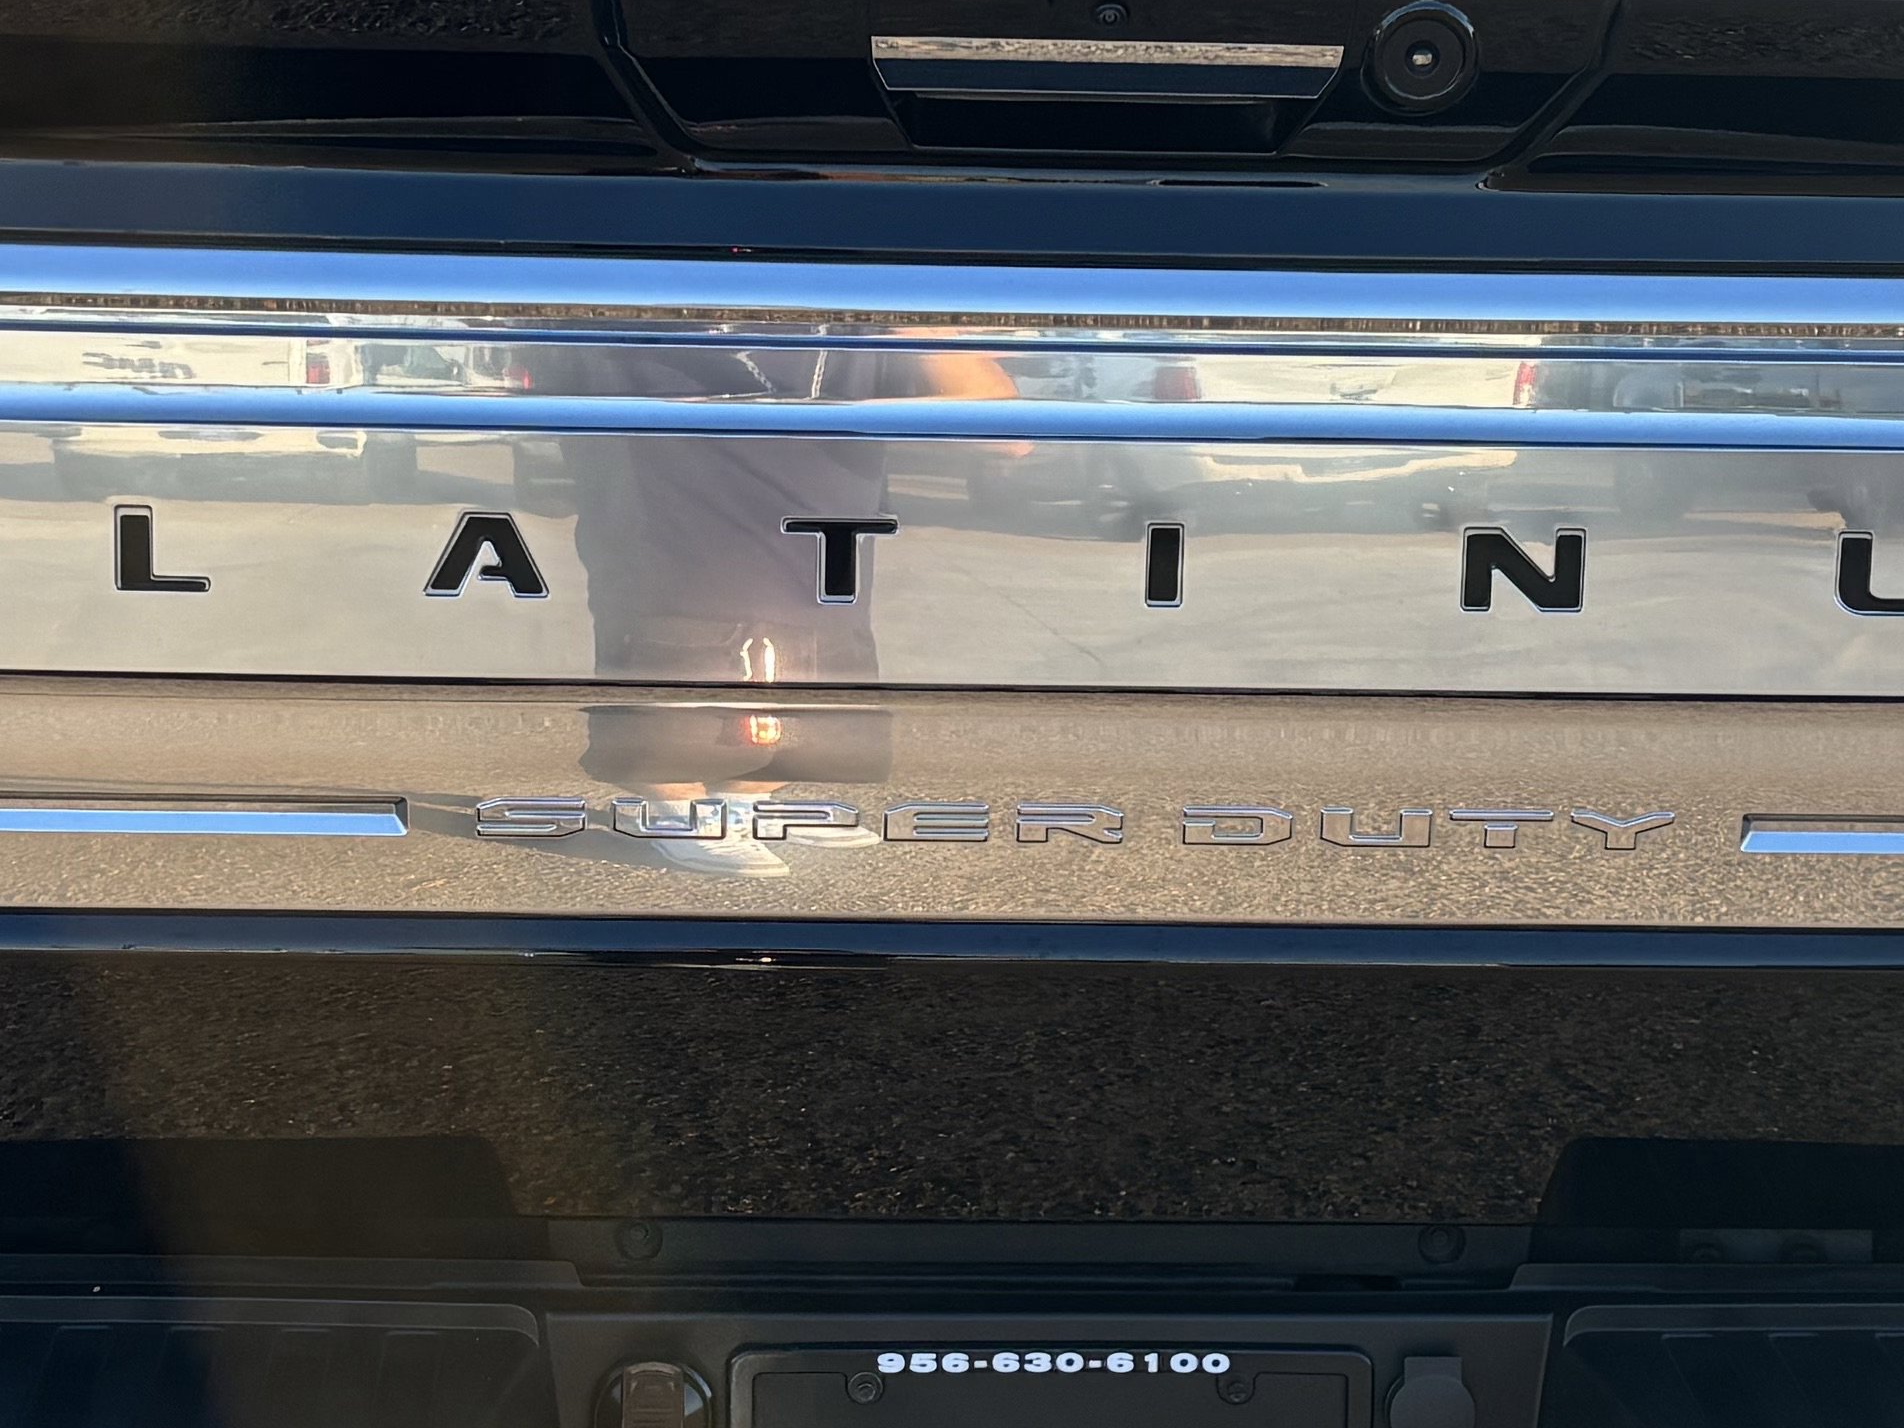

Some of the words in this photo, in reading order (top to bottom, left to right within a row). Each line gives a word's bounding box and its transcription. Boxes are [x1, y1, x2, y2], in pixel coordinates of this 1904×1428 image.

[476, 796, 1124, 844] SUPER
[1180, 803, 1676, 851] DUTY
[876, 1352, 1232, 1374] 956-630-6100
